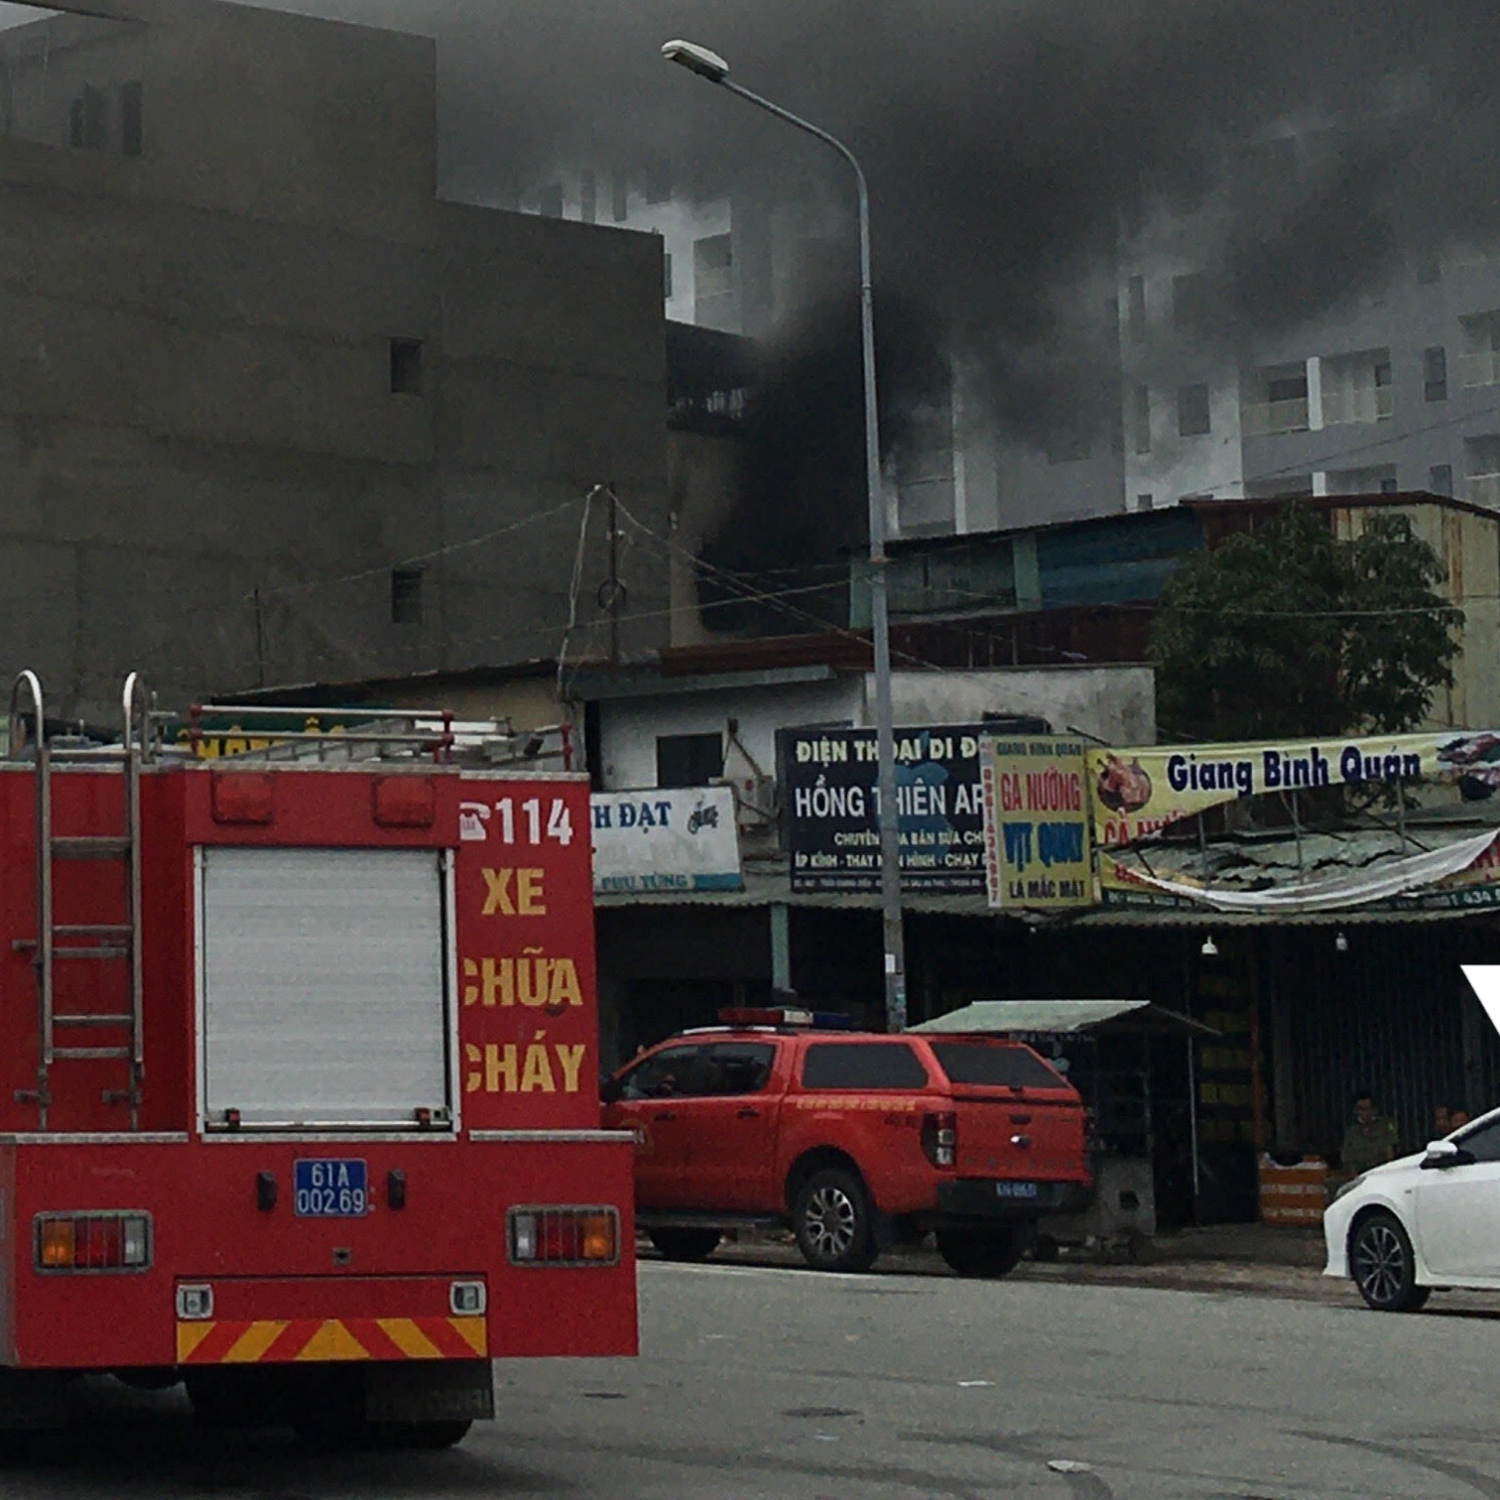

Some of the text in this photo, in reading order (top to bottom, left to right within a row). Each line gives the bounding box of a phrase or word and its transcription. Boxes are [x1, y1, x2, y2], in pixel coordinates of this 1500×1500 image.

[796, 736, 848, 767] ĐIỆN
[854, 738, 922, 766] THẠI
[929, 738, 953, 759] DI
[1167, 753, 1253, 797] Giang
[496, 798, 574, 845] 114
[619, 801, 672, 834] ĐẠT
[481, 868, 547, 915] XE
[312, 1162, 350, 1187] 61A
[298, 1188, 365, 1213] 00269
